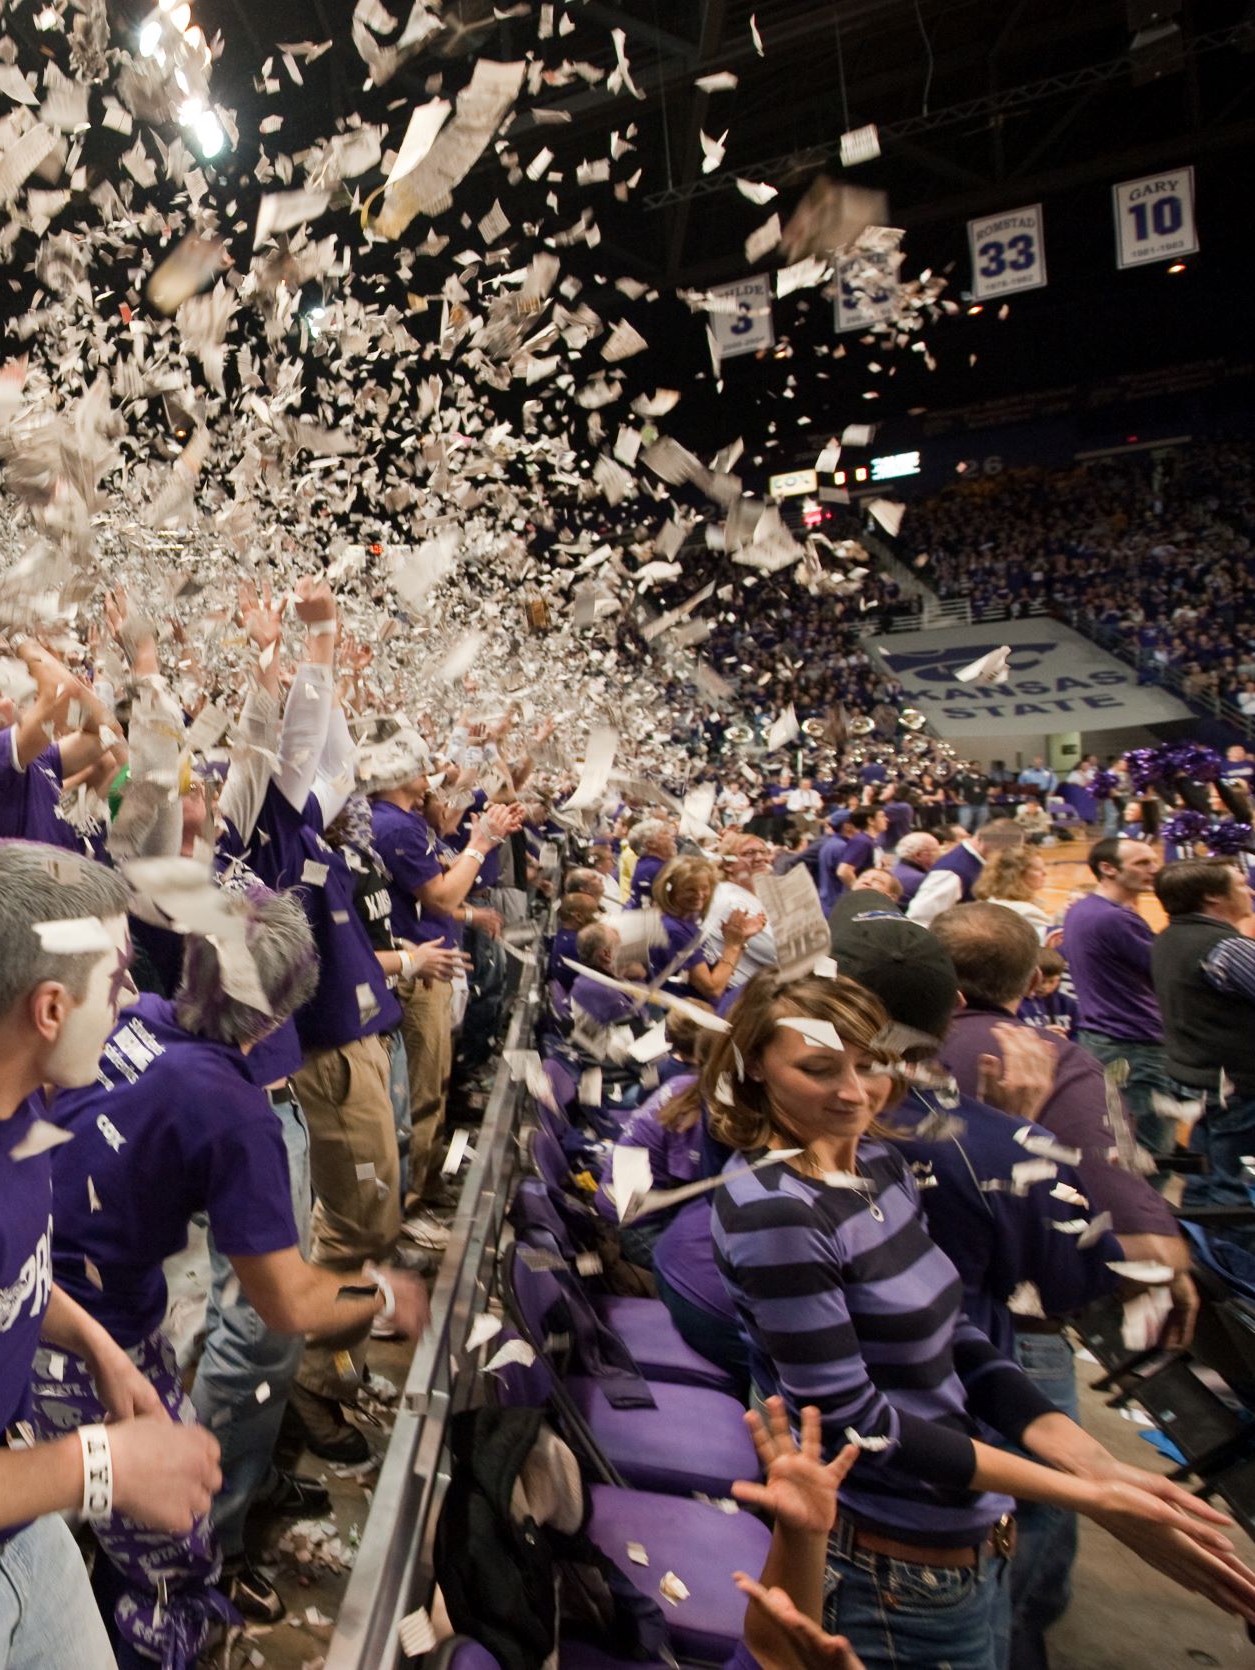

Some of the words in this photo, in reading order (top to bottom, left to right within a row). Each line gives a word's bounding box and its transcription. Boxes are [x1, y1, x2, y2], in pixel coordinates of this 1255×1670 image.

[1129, 179, 1179, 200] GARY
[977, 217, 1035, 241] ROMSTAD
[1128, 196, 1183, 241] 10
[979, 234, 1035, 278] 33
[730, 302, 753, 335] 3
[905, 670, 1128, 701] KANSAS
[943, 693, 1126, 719] STATE
